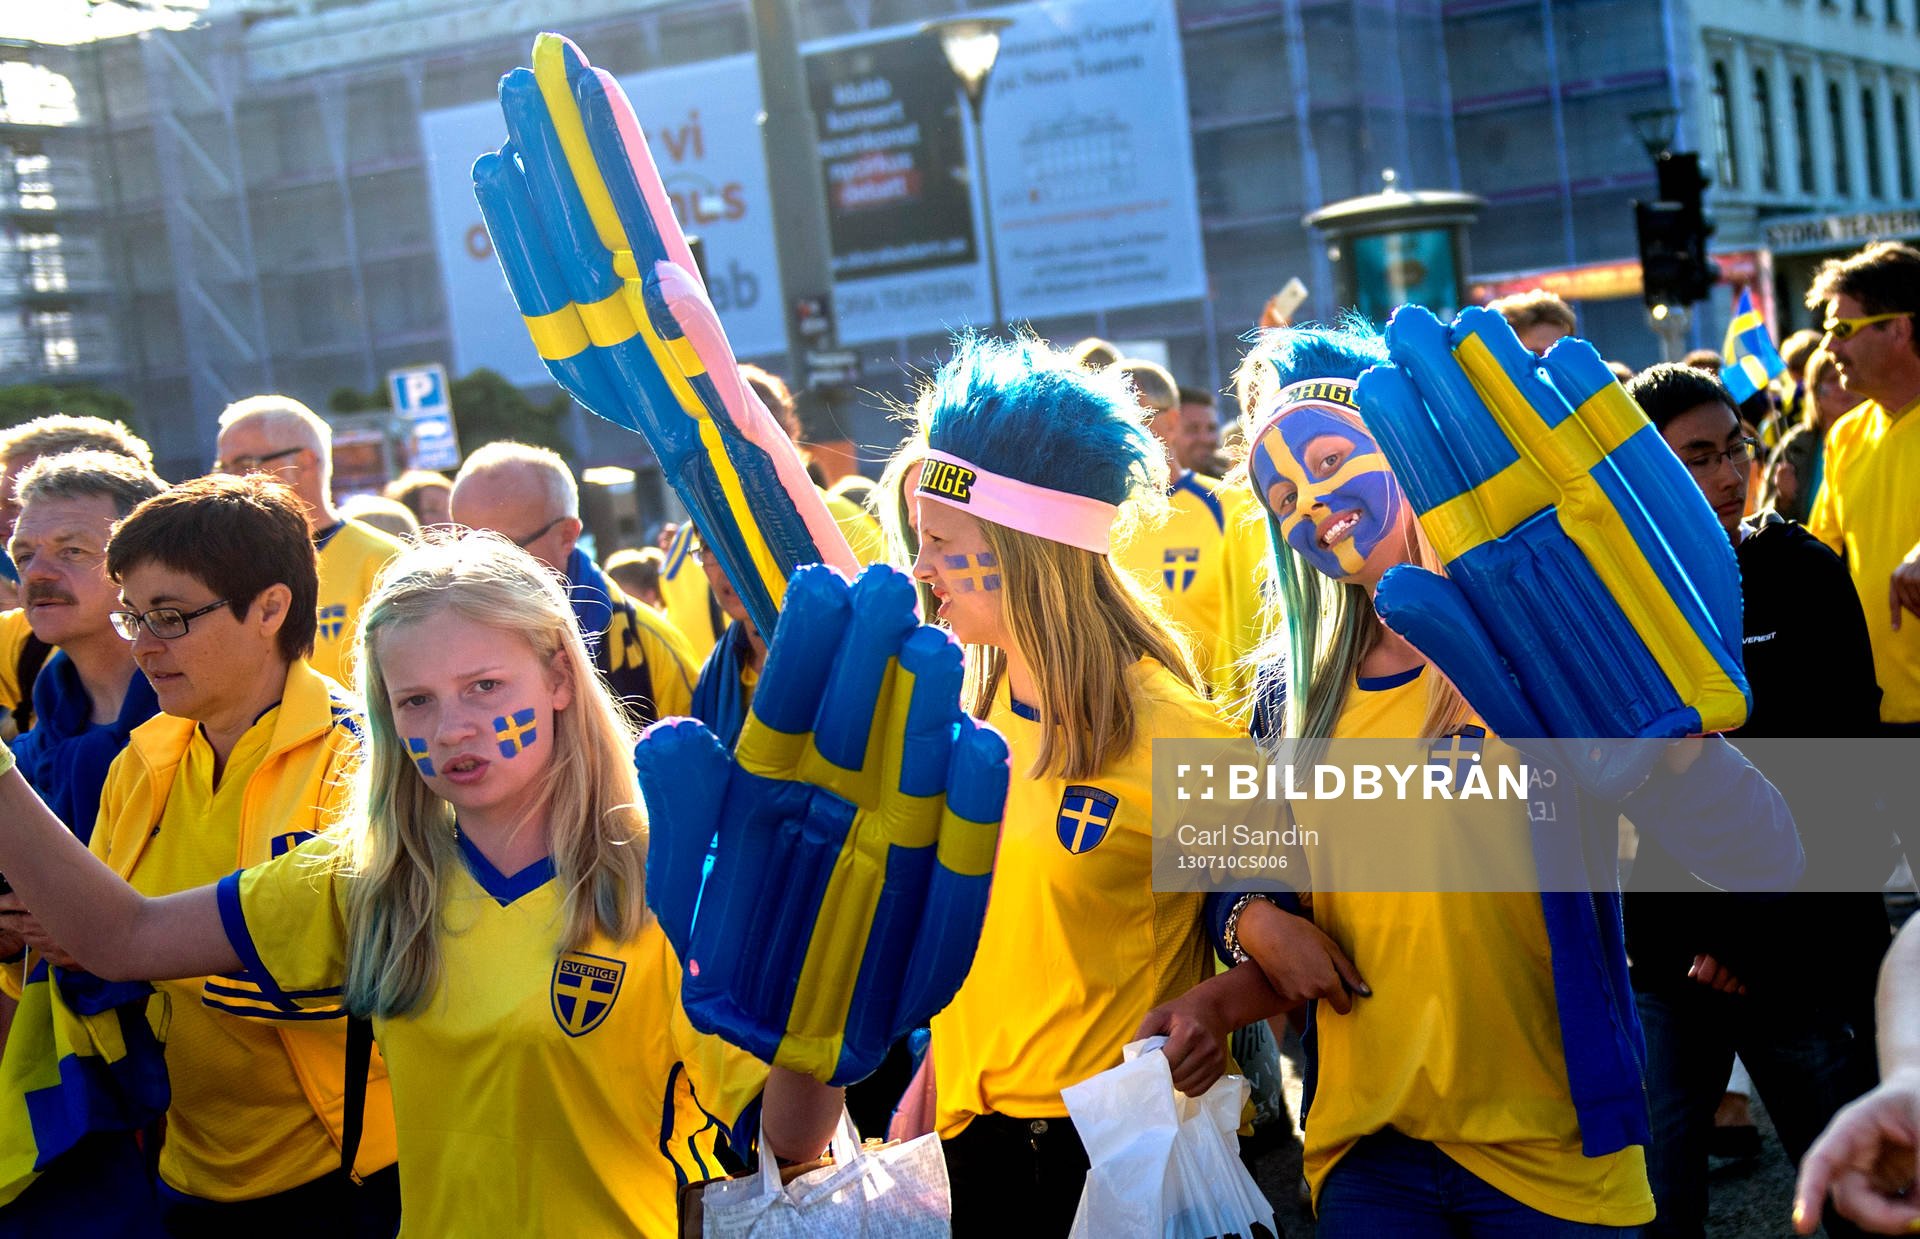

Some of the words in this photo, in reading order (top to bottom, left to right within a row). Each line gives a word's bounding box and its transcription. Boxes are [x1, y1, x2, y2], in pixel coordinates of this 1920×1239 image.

[661, 110, 706, 164] vi
[407, 372, 434, 413] P
[1288, 382, 1360, 411] RIG
[920, 458, 976, 503] RIGE
[1742, 630, 1777, 645] VEREST
[562, 960, 618, 981] SVERIGE
